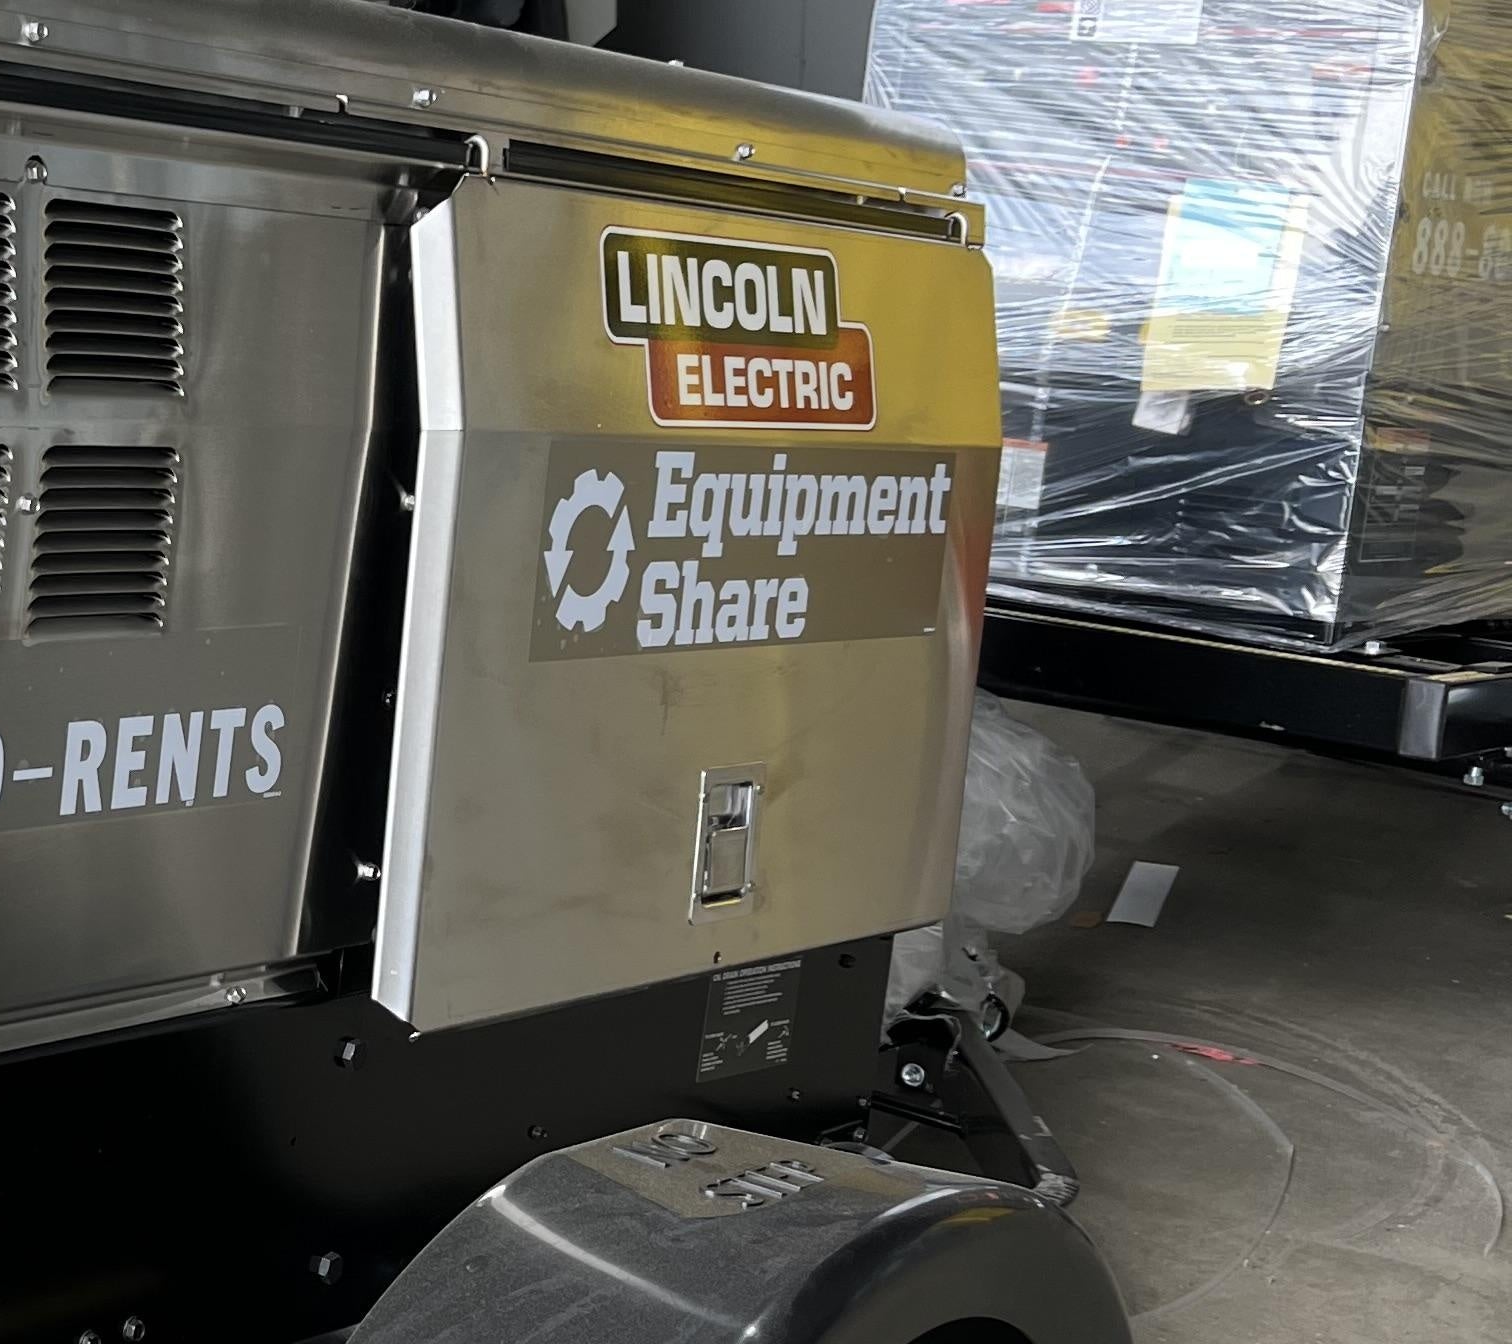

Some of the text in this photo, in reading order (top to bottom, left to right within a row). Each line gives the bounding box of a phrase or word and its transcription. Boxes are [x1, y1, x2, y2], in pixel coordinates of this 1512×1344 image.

[616, 250, 827, 335] LINCOLN
[676, 353, 854, 411] ELECTRIC
[647, 451, 951, 558] Equipment
[636, 558, 809, 648] Share
[611, 1133, 718, 1169] NO
[699, 1159, 825, 1209] STEP
